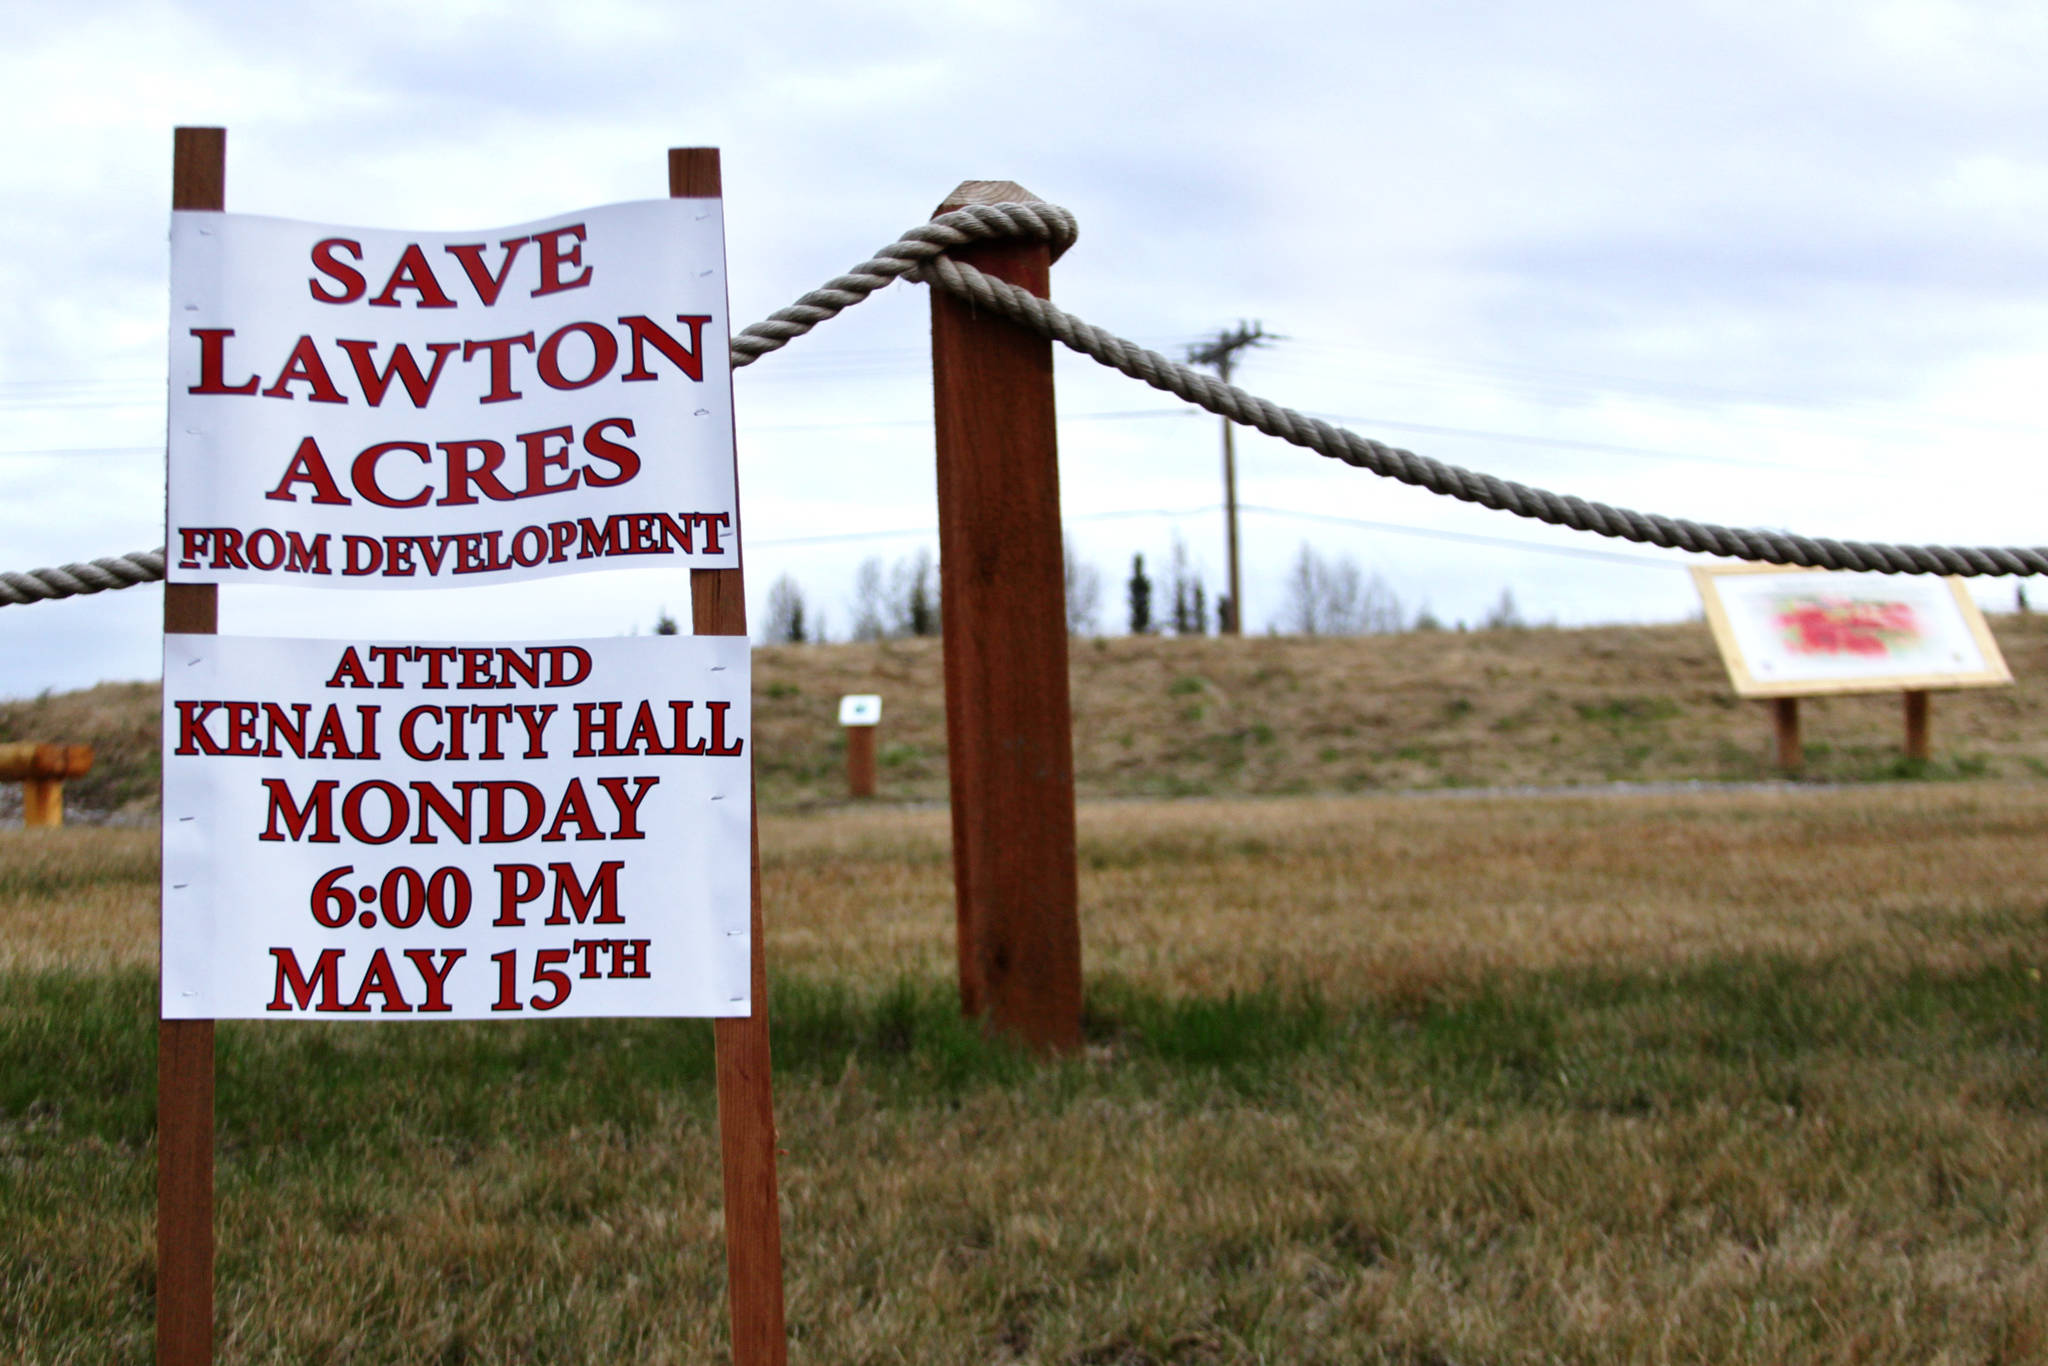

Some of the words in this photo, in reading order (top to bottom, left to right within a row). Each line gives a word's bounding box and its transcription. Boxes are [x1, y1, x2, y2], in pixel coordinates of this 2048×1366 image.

[309, 223, 594, 308] SAVE
[188, 314, 713, 408] LAWTON
[265, 418, 642, 509] ACRES
[177, 527, 333, 576] FROM
[341, 511, 731, 578] DEVELOPMENT
[325, 645, 593, 690] ATTEND
[173, 698, 382, 761] KENAI
[398, 703, 559, 762] CITY
[572, 698, 745, 759] HALL
[258, 775, 661, 846] MONDAY
[310, 864, 473, 930] 6:00
[492, 860, 626, 928] PM
[265, 946, 468, 1013] MAY
[490, 937, 652, 1013] 15TH
